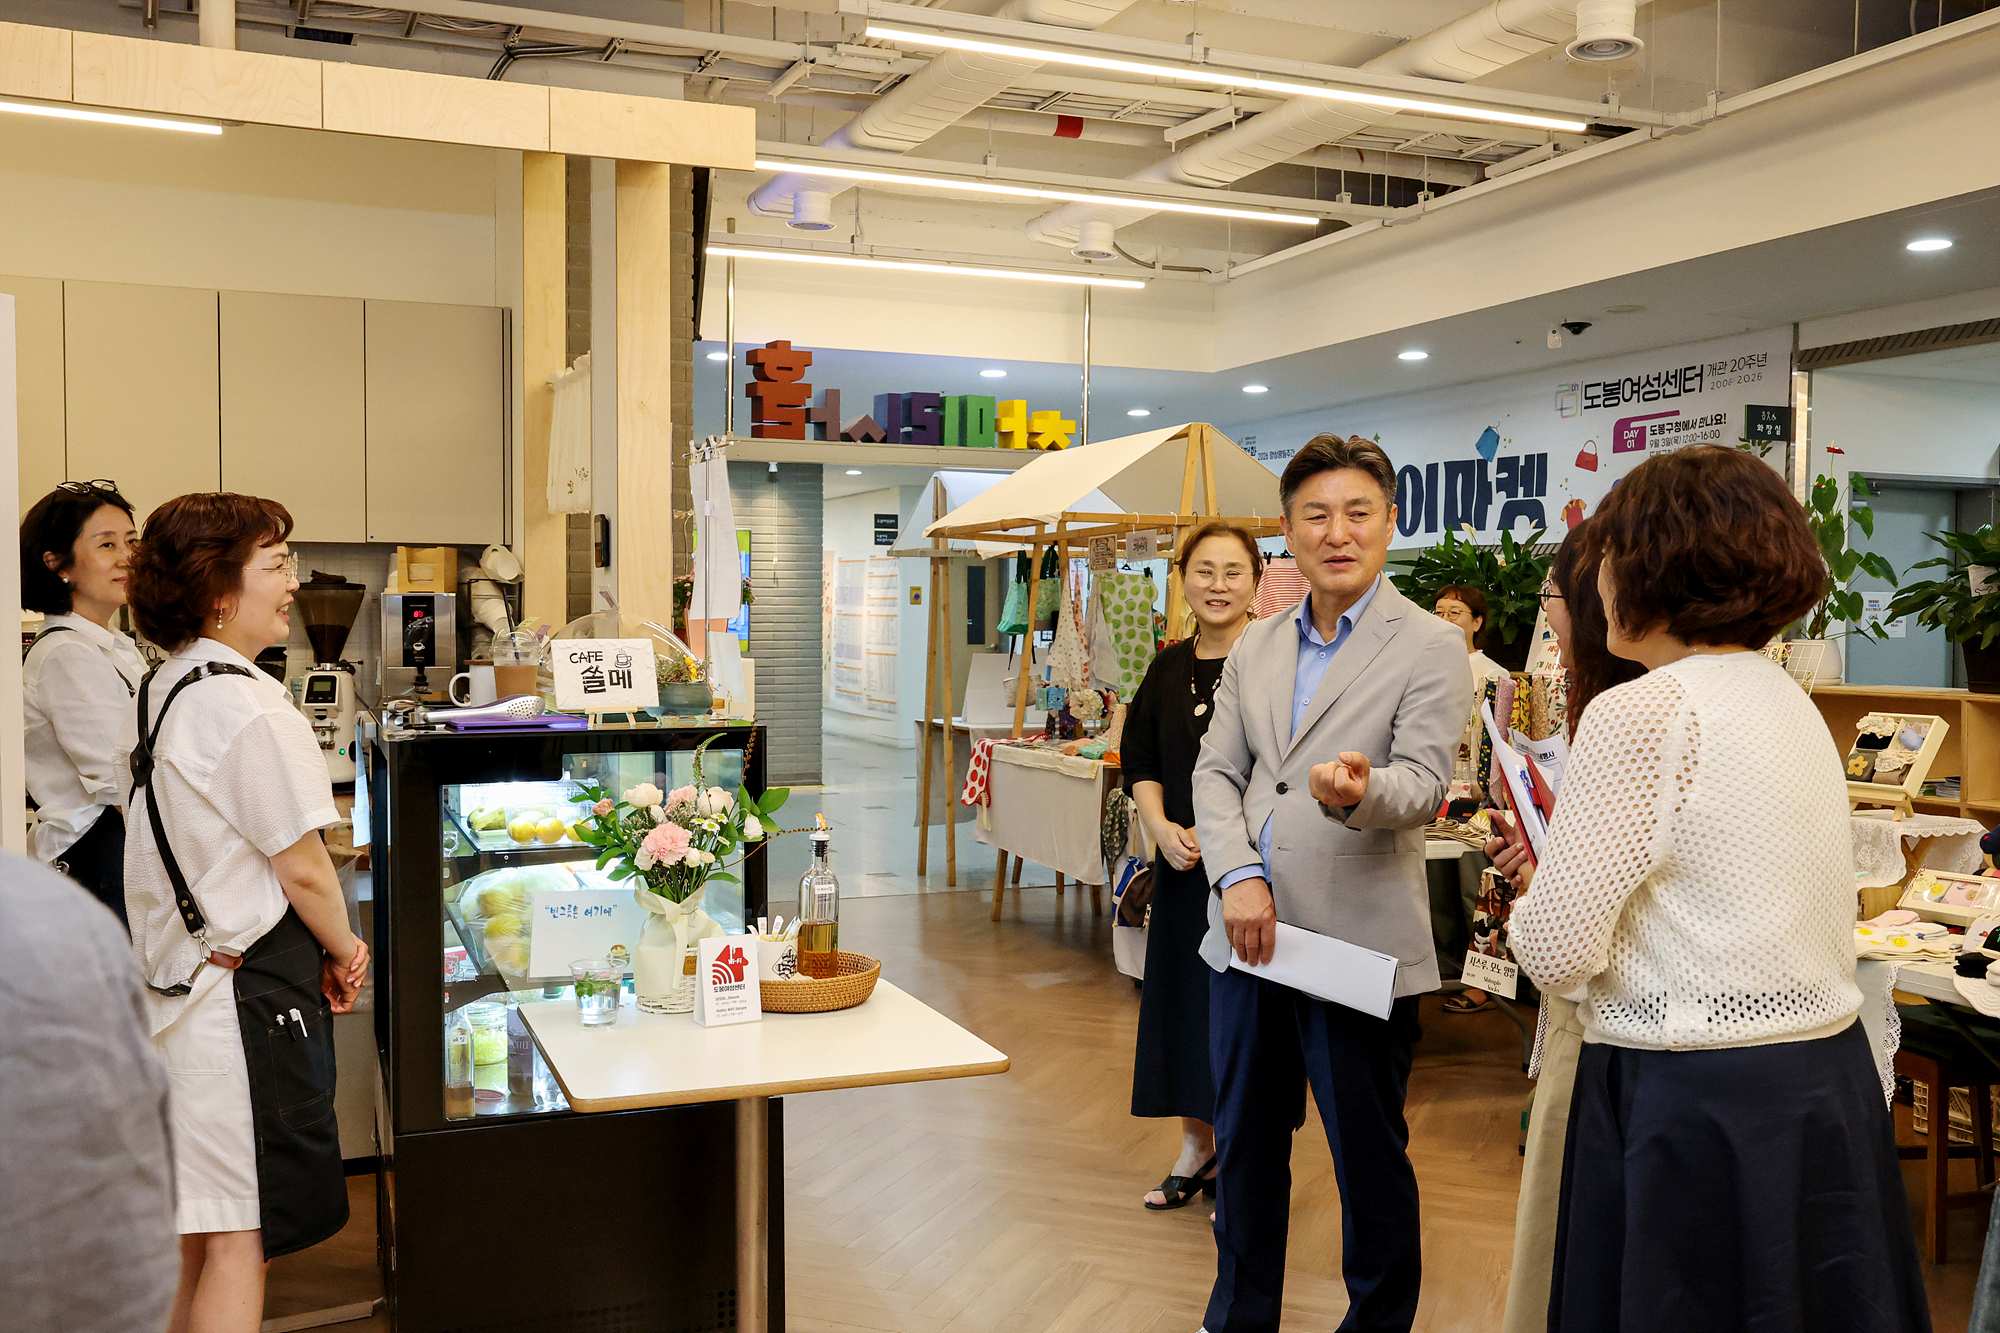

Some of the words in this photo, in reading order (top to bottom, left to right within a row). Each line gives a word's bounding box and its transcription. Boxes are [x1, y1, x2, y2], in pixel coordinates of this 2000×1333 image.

[1707, 361, 1727, 377] 개관
[1730, 352, 1767, 372] 20주년
[1583, 364, 1704, 410] 도봉여성센터
[1649, 418, 1698, 436] 도봉구청에서
[1698, 412, 1727, 429] 만나요!
[1757, 423, 1782, 436] 화장실
[1623, 428, 1640, 440] DAY
[1626, 439, 1635, 449] 01
[1649, 438, 1660, 449] 9월
[569, 651, 603, 663] CAFE
